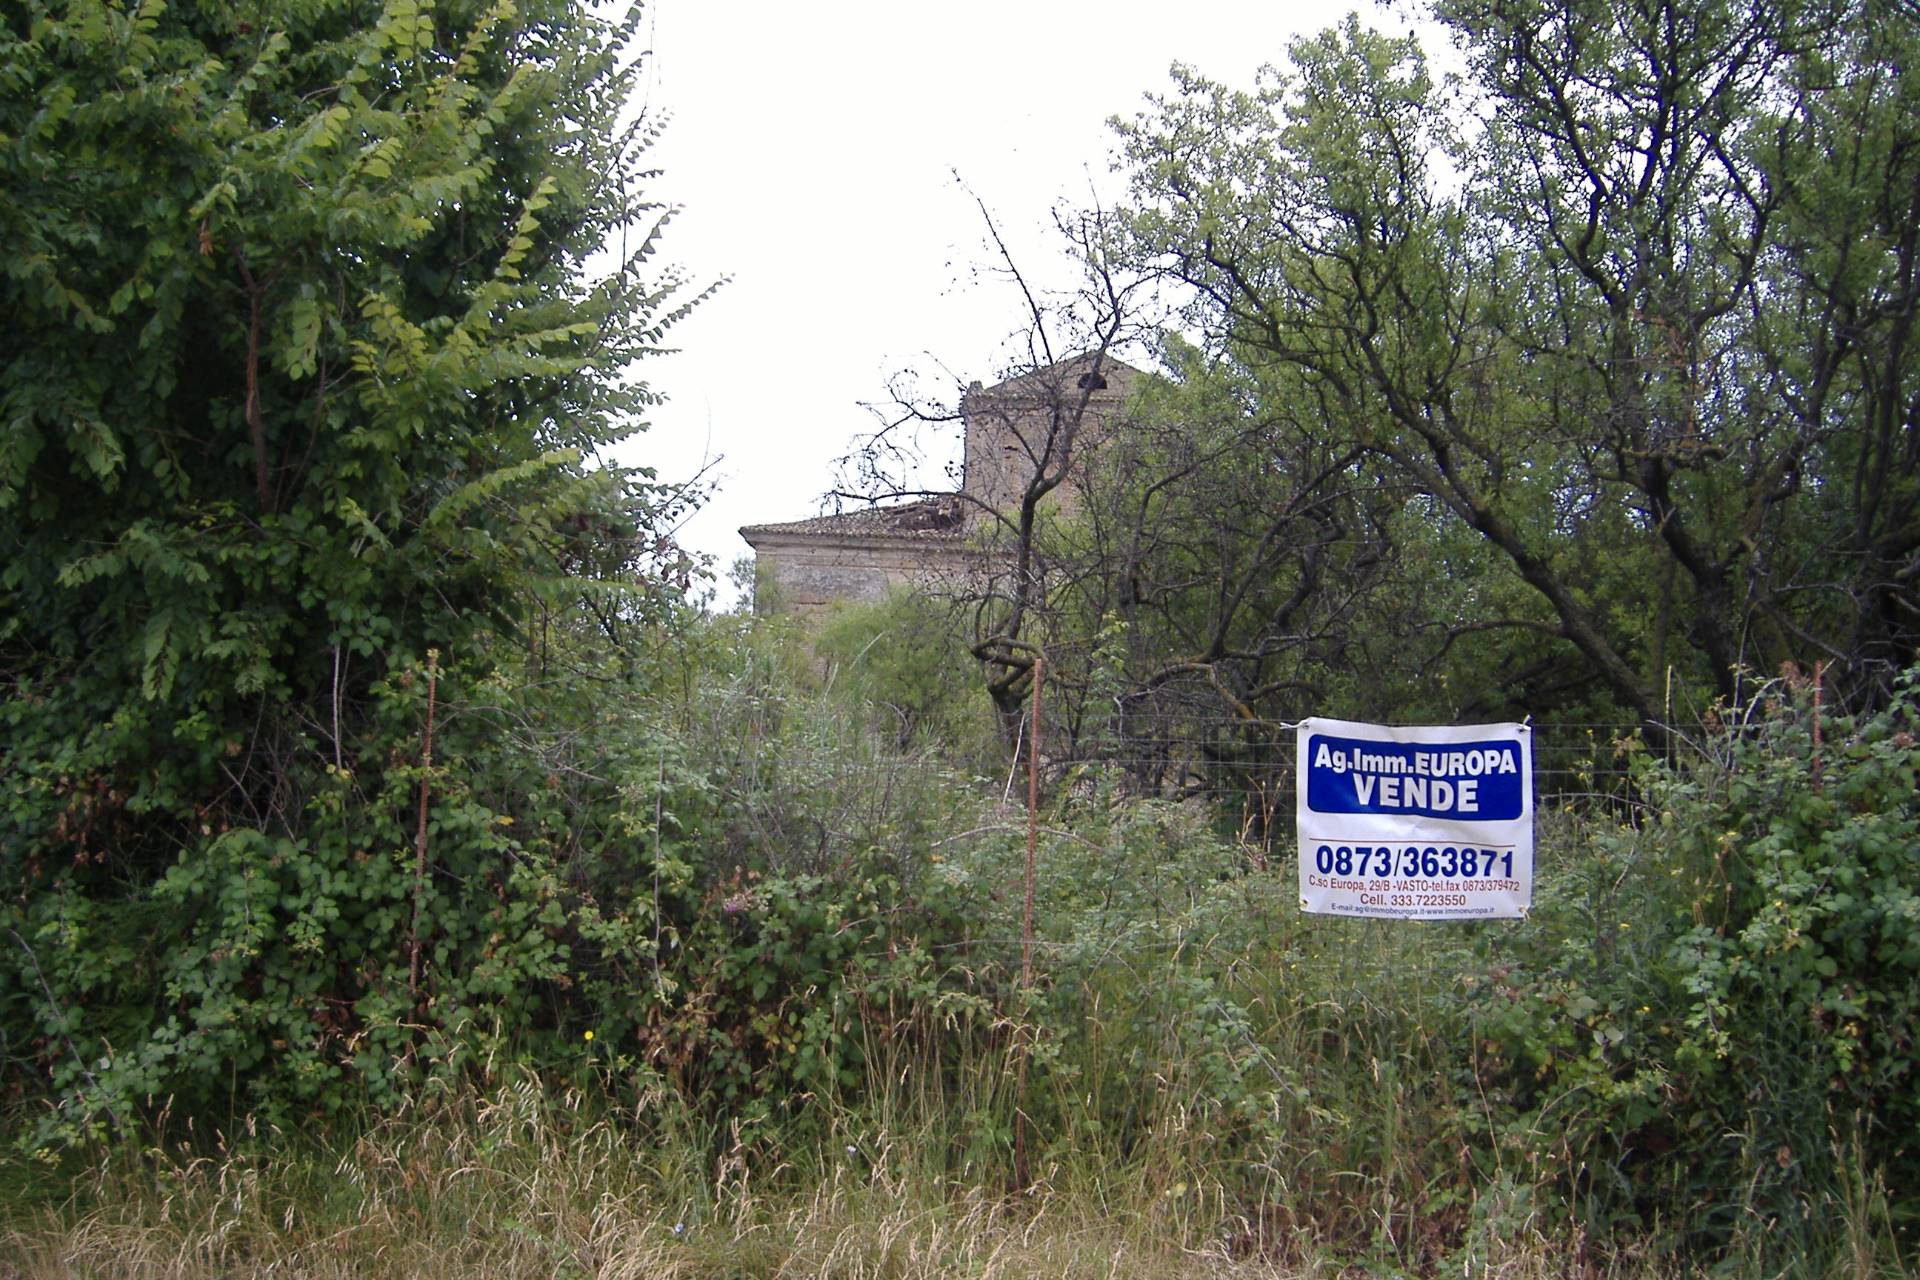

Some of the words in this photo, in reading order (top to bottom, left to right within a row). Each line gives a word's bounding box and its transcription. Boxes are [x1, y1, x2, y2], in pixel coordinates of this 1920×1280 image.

[1314, 743, 1516, 777] Ag.Imm.EUROPA
[1353, 773, 1479, 812] VENDE
[1316, 845, 1513, 878] 0873/363871
[1309, 874, 1328, 888] C.so
[1330, 877, 1367, 892] Europa,
[1369, 880, 1390, 892] 29/B
[1463, 880, 1520, 892] 0873/379472
[1360, 893, 1386, 905] Cell.
[1391, 894, 1466, 907] 333.7223550
